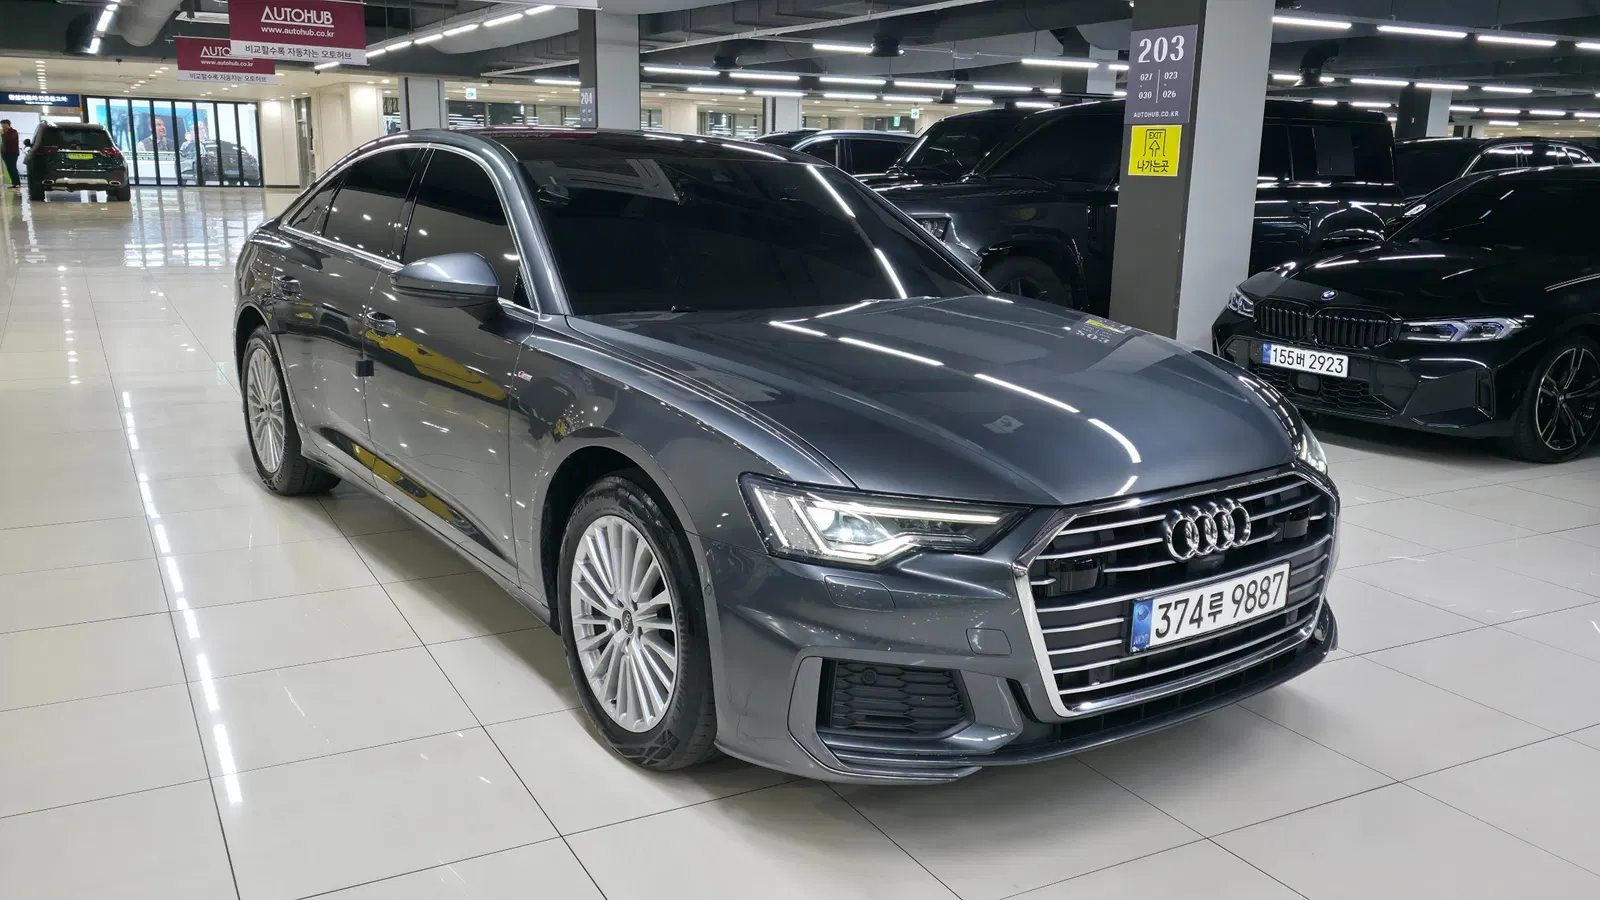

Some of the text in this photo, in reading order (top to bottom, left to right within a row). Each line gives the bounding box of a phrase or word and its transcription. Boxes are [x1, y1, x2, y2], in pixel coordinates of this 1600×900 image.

[261, 6, 334, 25] AUTOHUB
[261, 26, 335, 38] www.autohub.co.kr
[201, 46, 231, 56] AUTO
[245, 45, 352, 60] 비교할수록 자동차는 오토허브
[1138, 35, 1185, 63] 203
[1140, 71, 1178, 81] 027 023
[581, 92, 592, 105] 204
[1138, 90, 1176, 100] 030 026
[1137, 160, 1169, 172] 나가는곳
[1273, 348, 1344, 374] 155버 2923
[1155, 571, 1285, 639] 374루 9887
